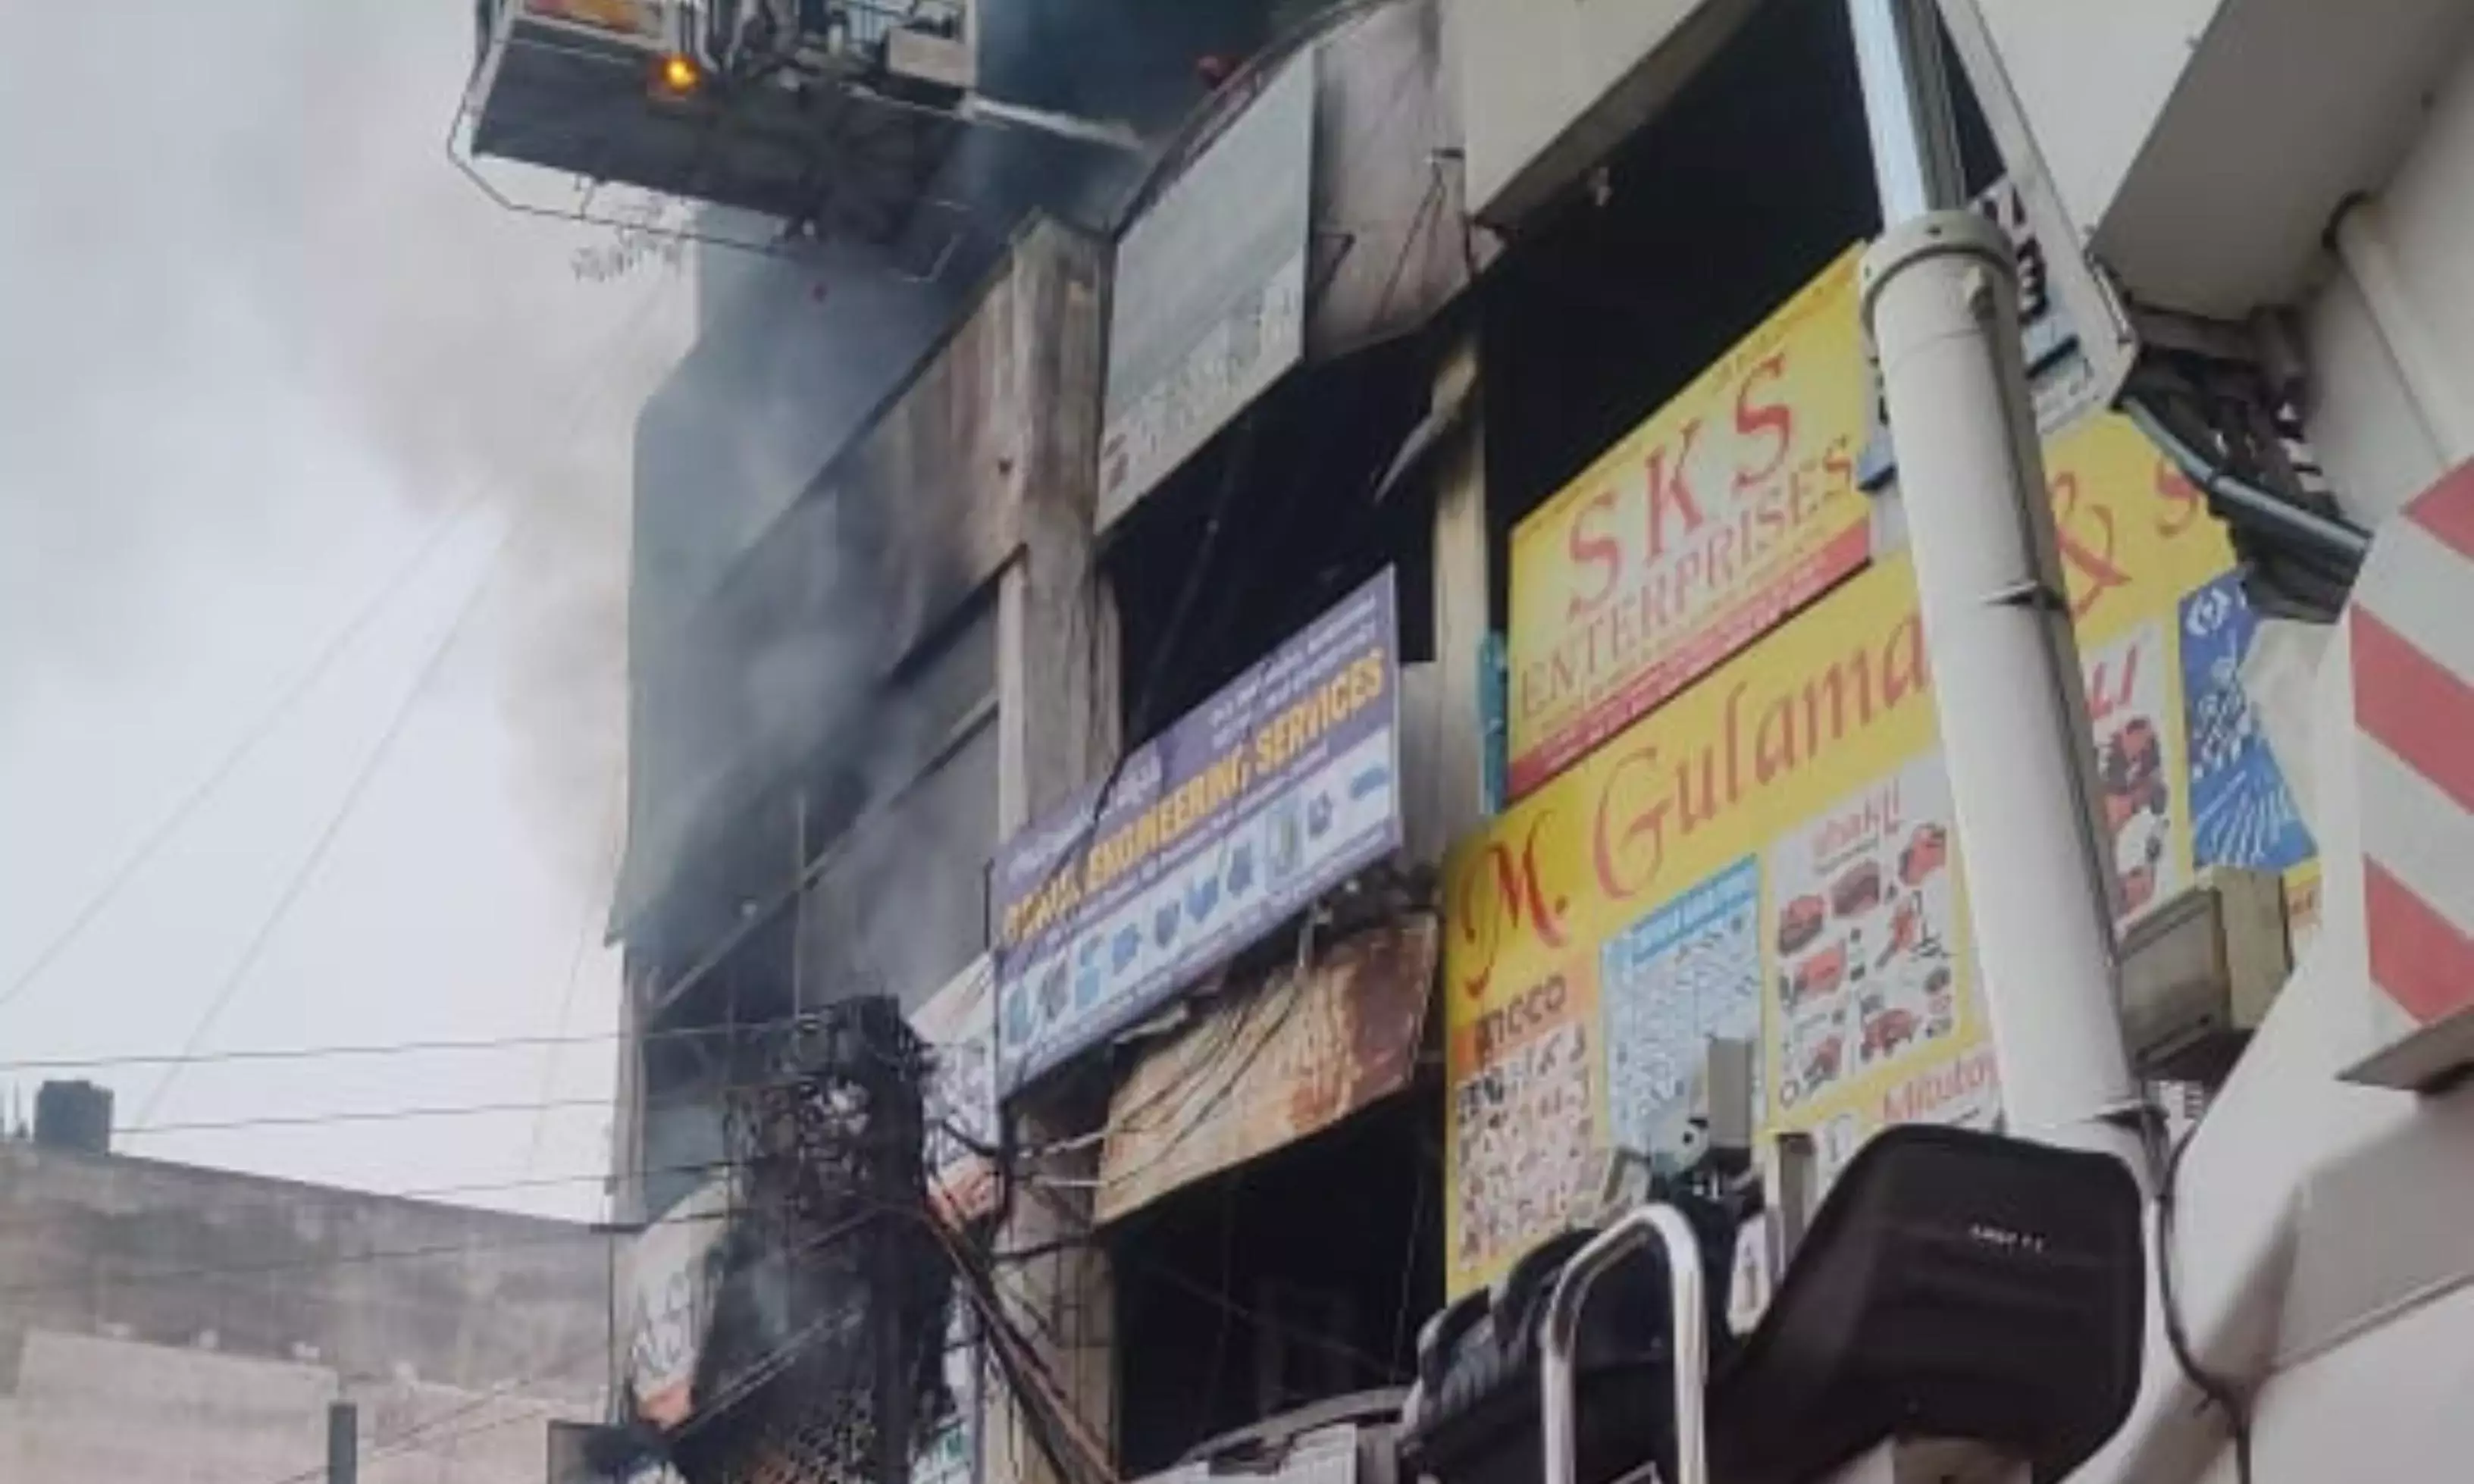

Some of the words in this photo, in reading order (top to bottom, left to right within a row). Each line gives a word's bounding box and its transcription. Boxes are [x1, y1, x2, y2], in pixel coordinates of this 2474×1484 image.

[1520, 432, 1854, 723] ENTERPRISES
[1085, 741, 1252, 896] ENGINEERING
[1255, 647, 1386, 775] SERVICES
